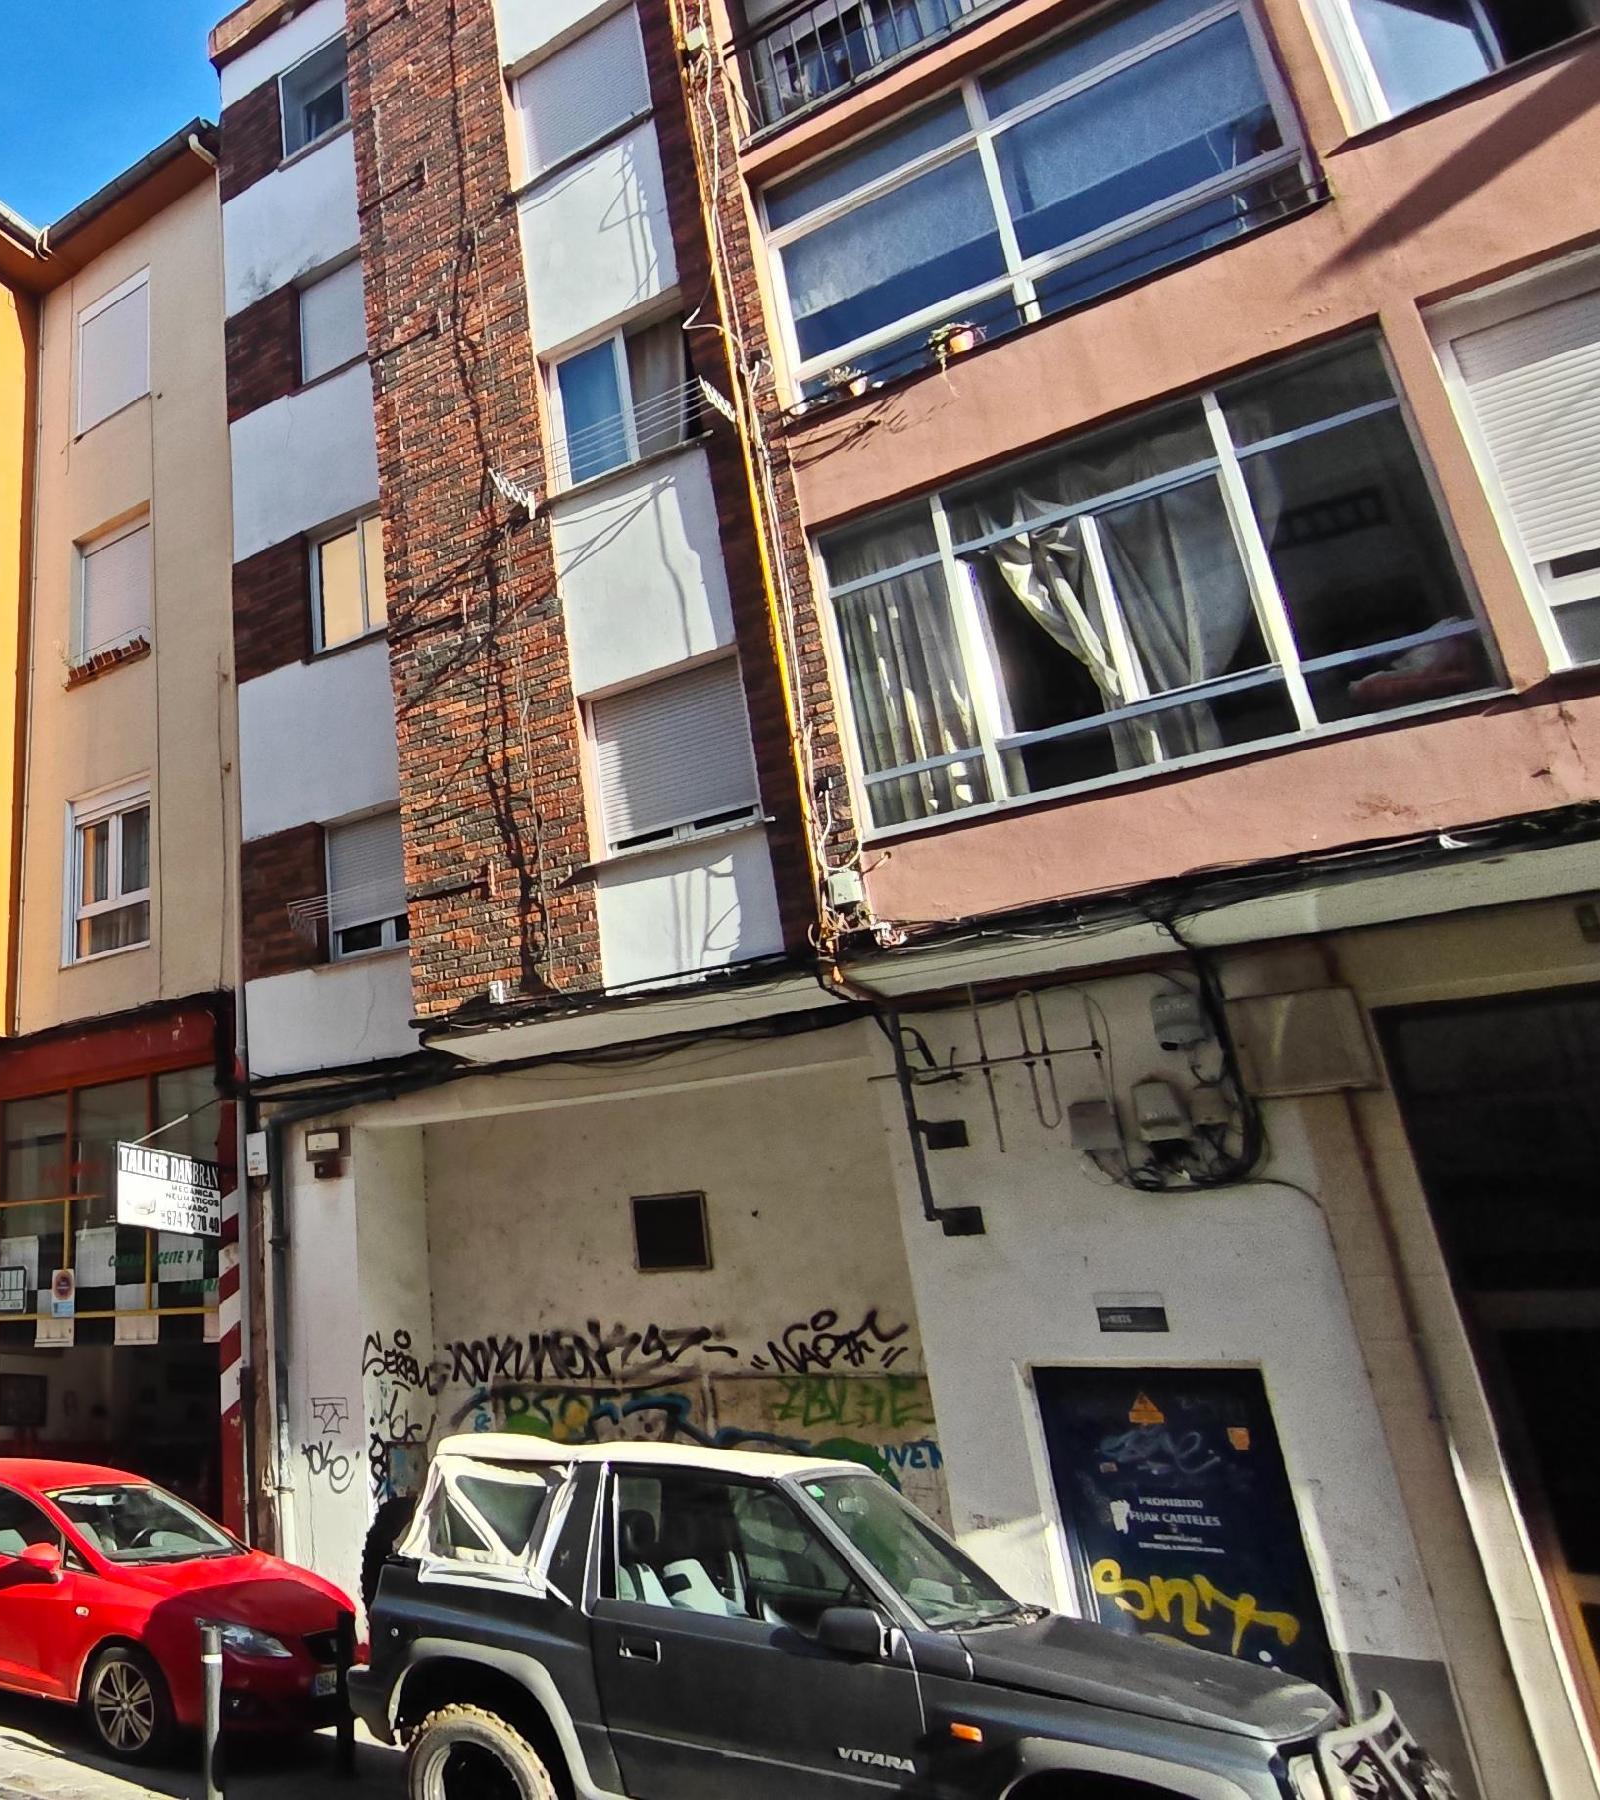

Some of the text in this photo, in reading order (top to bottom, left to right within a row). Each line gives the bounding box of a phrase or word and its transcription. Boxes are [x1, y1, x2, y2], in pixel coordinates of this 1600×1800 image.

[120, 1146, 168, 1180] TALLER
[170, 1156, 219, 1189] DANBRAN
[165, 1192, 220, 1207] NEUMATICOS
[176, 1202, 208, 1214] LAVADO
[1138, 1496, 1204, 1509] PROHIBIDO
[1128, 1509, 1222, 1527] FIJAR CARTELES
[837, 1746, 917, 1775] VITARA
